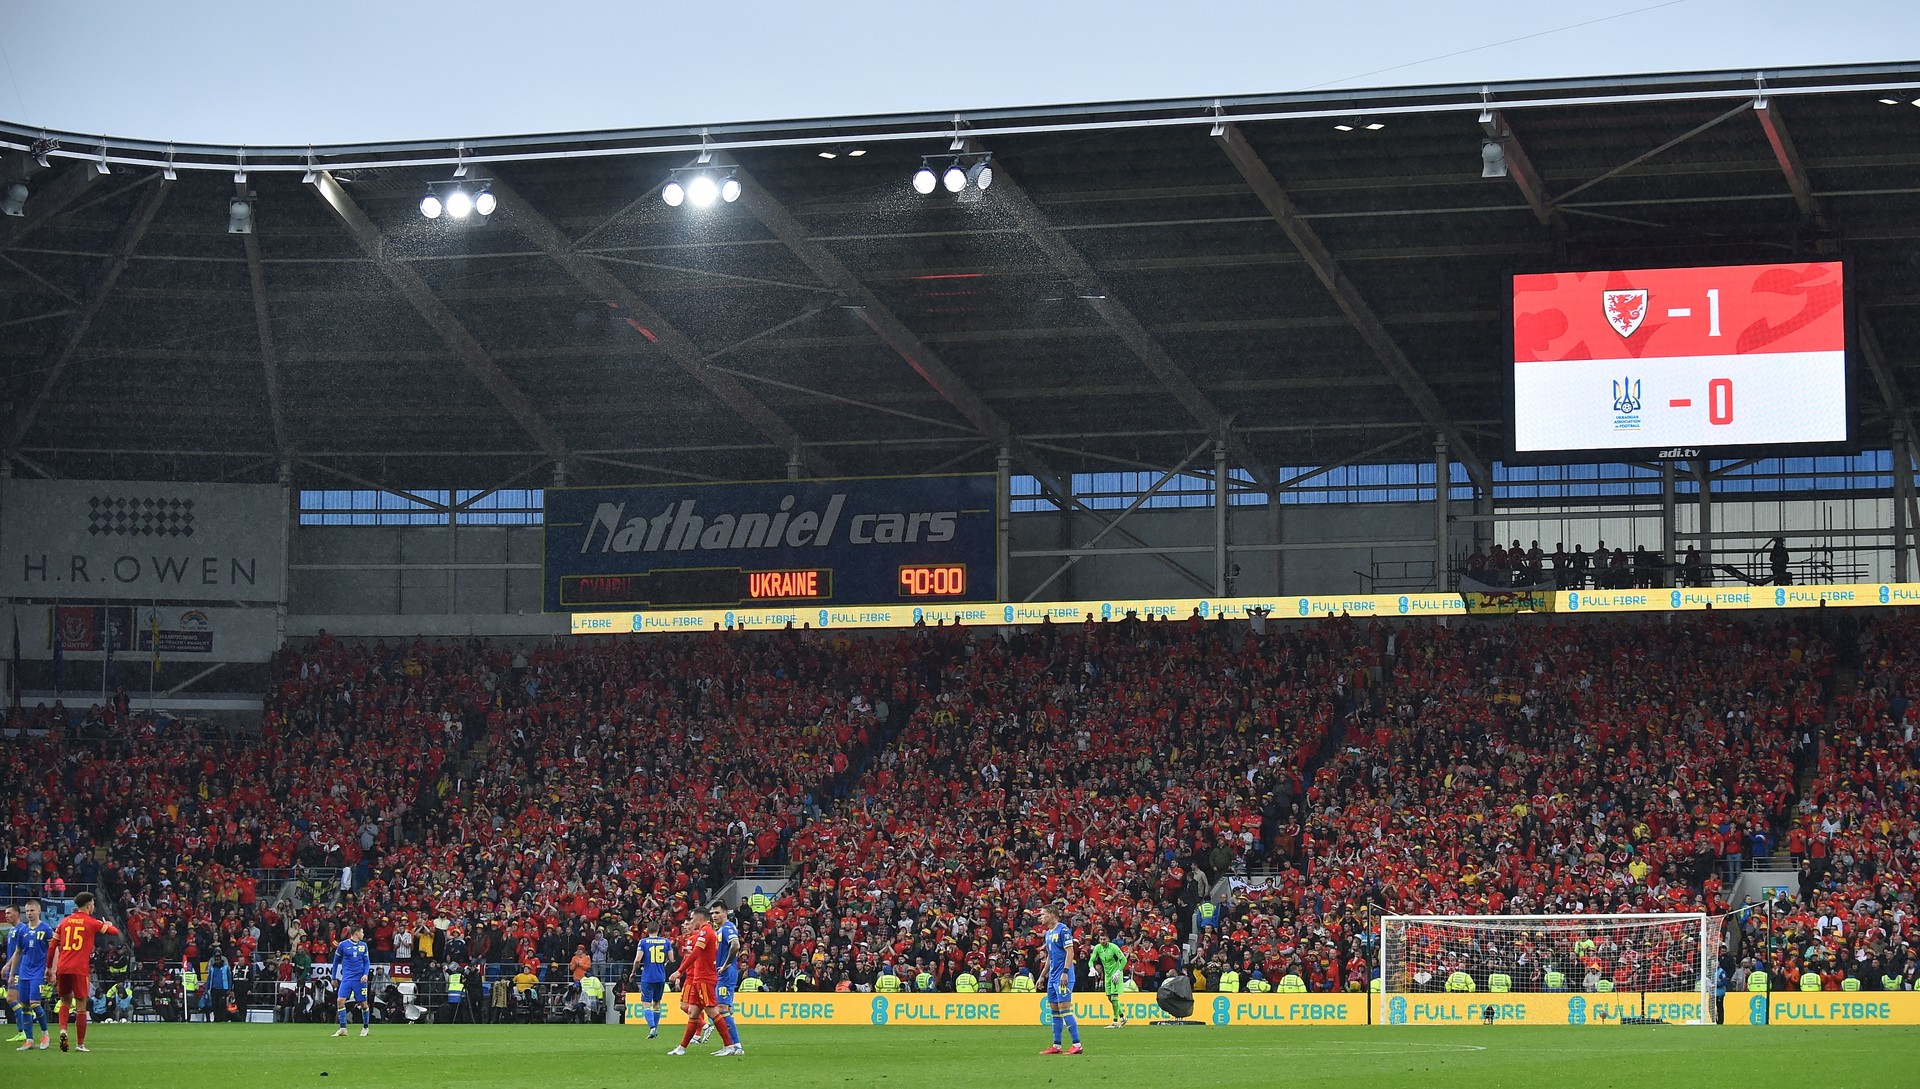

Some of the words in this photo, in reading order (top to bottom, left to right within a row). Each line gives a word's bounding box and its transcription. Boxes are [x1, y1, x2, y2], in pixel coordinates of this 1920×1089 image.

[1706, 289, 1721, 336] 1
[1709, 378, 1733, 425] 0
[1658, 448, 1700, 458] adi.tv
[581, 494, 847, 554] Nathaniel
[849, 511, 958, 544] cars
[750, 571, 818, 598] UKRAINE
[901, 567, 963, 595] 90:00
[1582, 596, 1610, 607] FULL
[1613, 595, 1647, 606] FIBRE
[1684, 594, 1713, 605] FULL
[1715, 593, 1751, 603] FIBRE
[1789, 591, 1817, 602] FULL
[1820, 591, 1855, 601] FIBRE
[1143, 605, 1177, 616] FIBRE
[1213, 604, 1239, 615] FULL
[1312, 601, 1339, 612] FULL
[1342, 601, 1376, 611] FIBRE
[1411, 599, 1440, 610] FULL
[738, 615, 762, 624] FULL
[765, 614, 797, 624] FIBRE
[831, 613, 857, 623] FULL
[859, 612, 891, 623] FIBRE
[926, 611, 951, 621] FULL
[955, 610, 986, 620] FIBRE
[1017, 609, 1044, 619] FULL
[1046, 608, 1079, 618] FIBRE
[581, 618, 612, 629] FIBRE
[645, 617, 670, 628] FULL
[672, 616, 703, 627] FIBRE
[36, 931, 46, 940] 17
[62, 926, 86, 951] 15
[648, 945, 665, 964] 16
[718, 987, 728, 995] 10
[780, 1003, 834, 1018] FIBRE
[895, 1003, 940, 1019] FULL
[945, 1003, 1000, 1019] FIBRE
[1237, 1004, 1284, 1020] FULL
[1290, 1004, 1348, 1020] FIBRE
[1414, 1004, 1462, 1020] FULL
[1467, 1004, 1526, 1020] FIBRE
[1593, 1003, 1642, 1020] FULL
[1775, 1003, 1825, 1019] FULL
[1830, 1003, 1891, 1019] FIBRE
